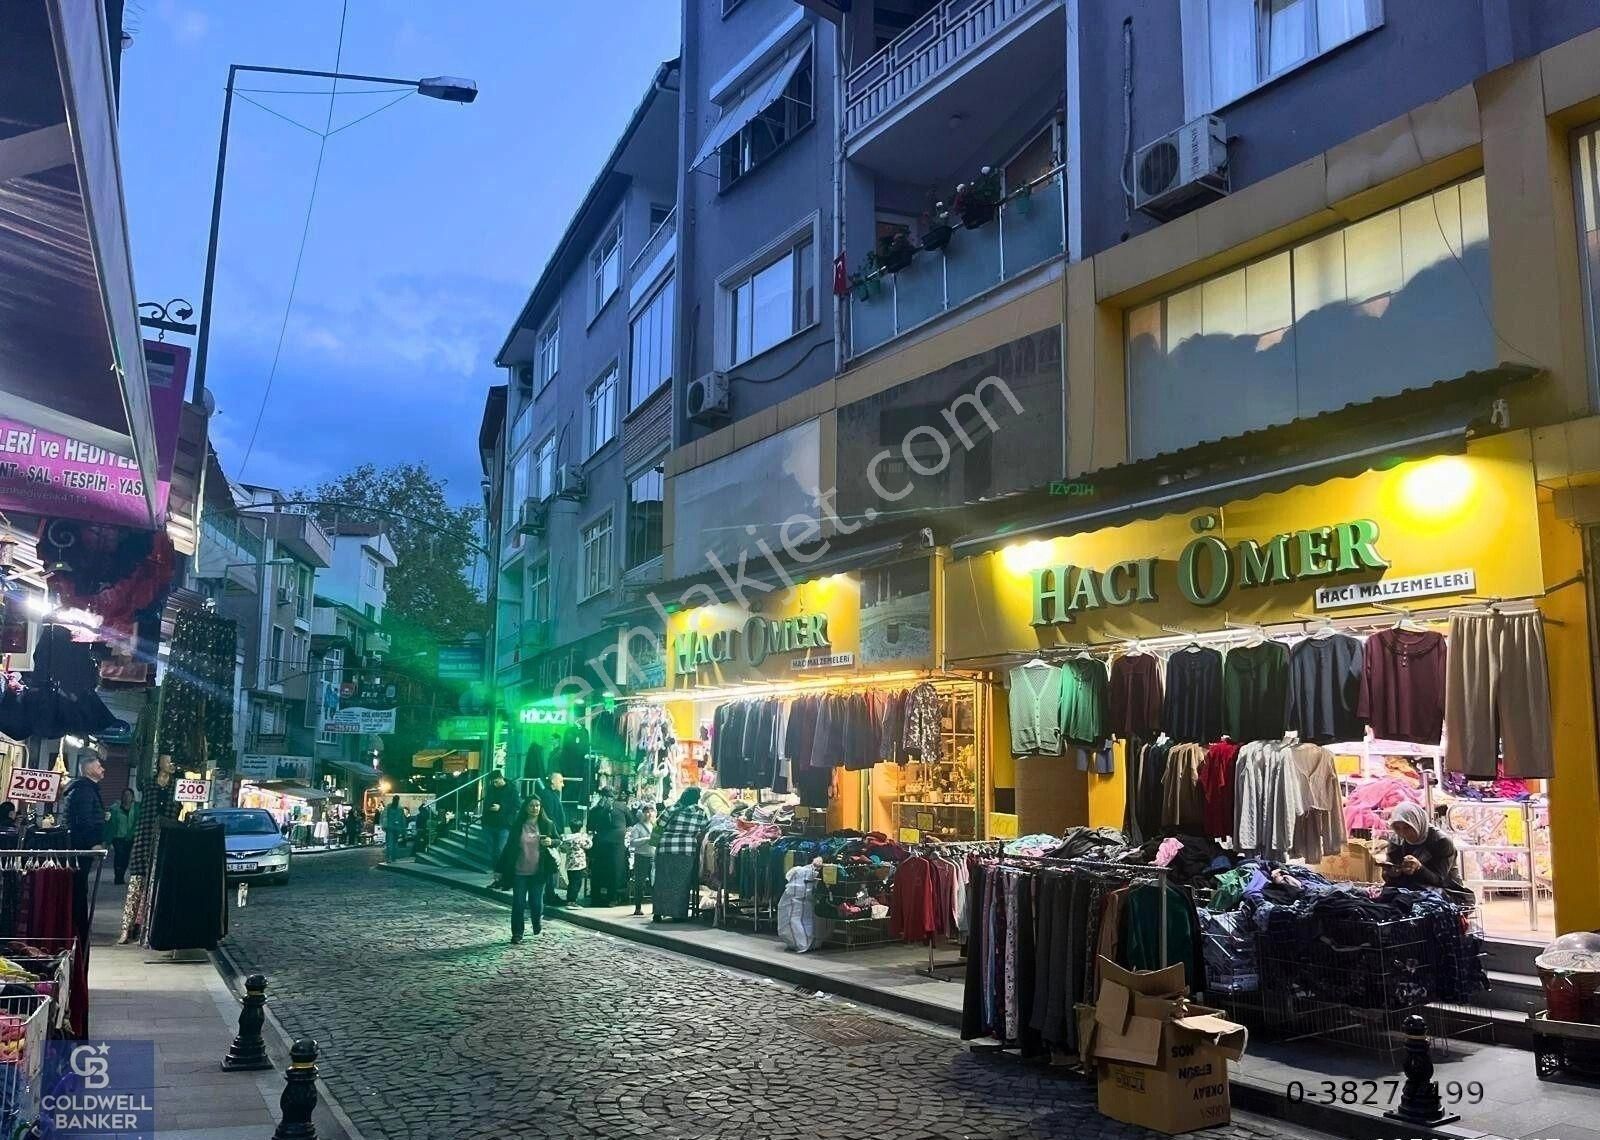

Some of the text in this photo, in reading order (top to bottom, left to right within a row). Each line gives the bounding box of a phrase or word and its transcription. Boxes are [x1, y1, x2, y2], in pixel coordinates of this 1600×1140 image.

[40, 440, 60, 459] ve
[63, 470, 109, 492] TESPİH
[1029, 514, 1391, 627] HACI ÖMER
[1319, 572, 1469, 604] HACI MALZEMELERİ
[673, 601, 832, 675] HACI ÖMER
[13, 776, 50, 791] 200
[178, 784, 204, 794] 200
